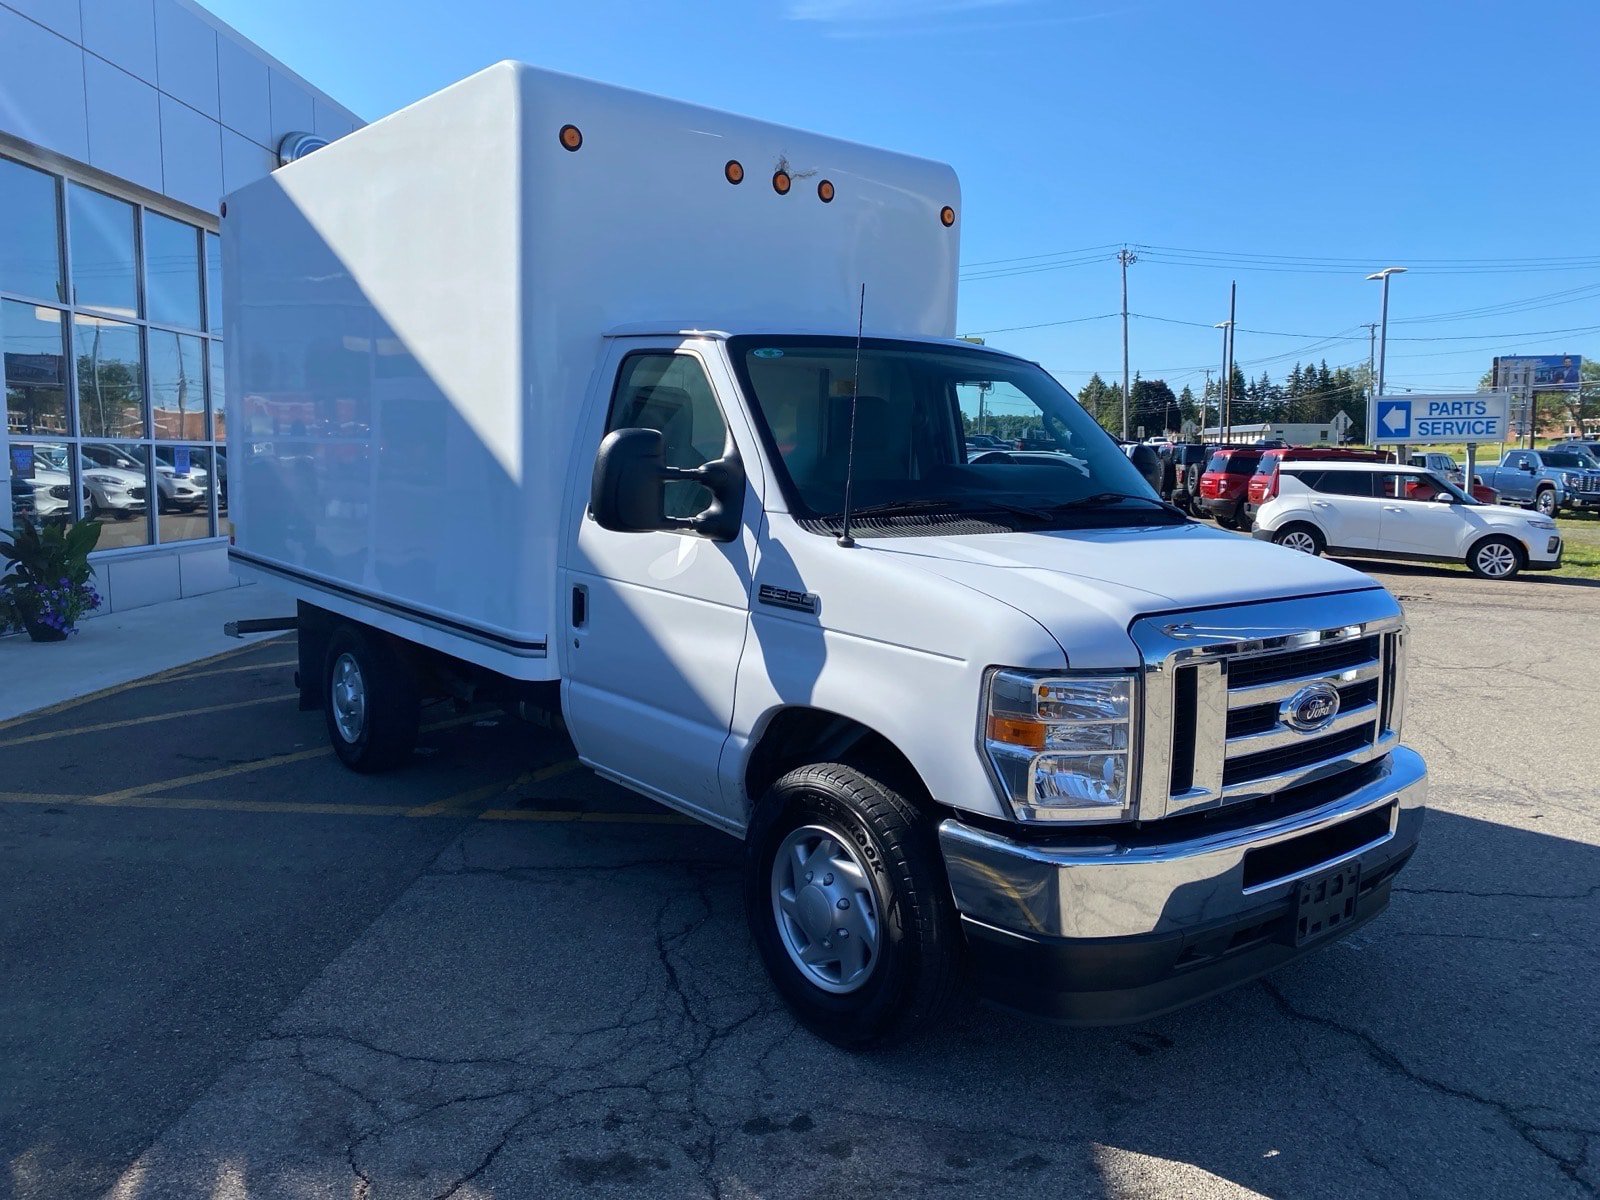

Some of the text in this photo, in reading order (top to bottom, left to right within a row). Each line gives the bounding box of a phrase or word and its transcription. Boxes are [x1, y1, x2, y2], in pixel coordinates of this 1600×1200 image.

[1429, 400, 1487, 416] PARTS
[1418, 420, 1497, 436] SERVICE
[1306, 699, 1331, 720] Ford
